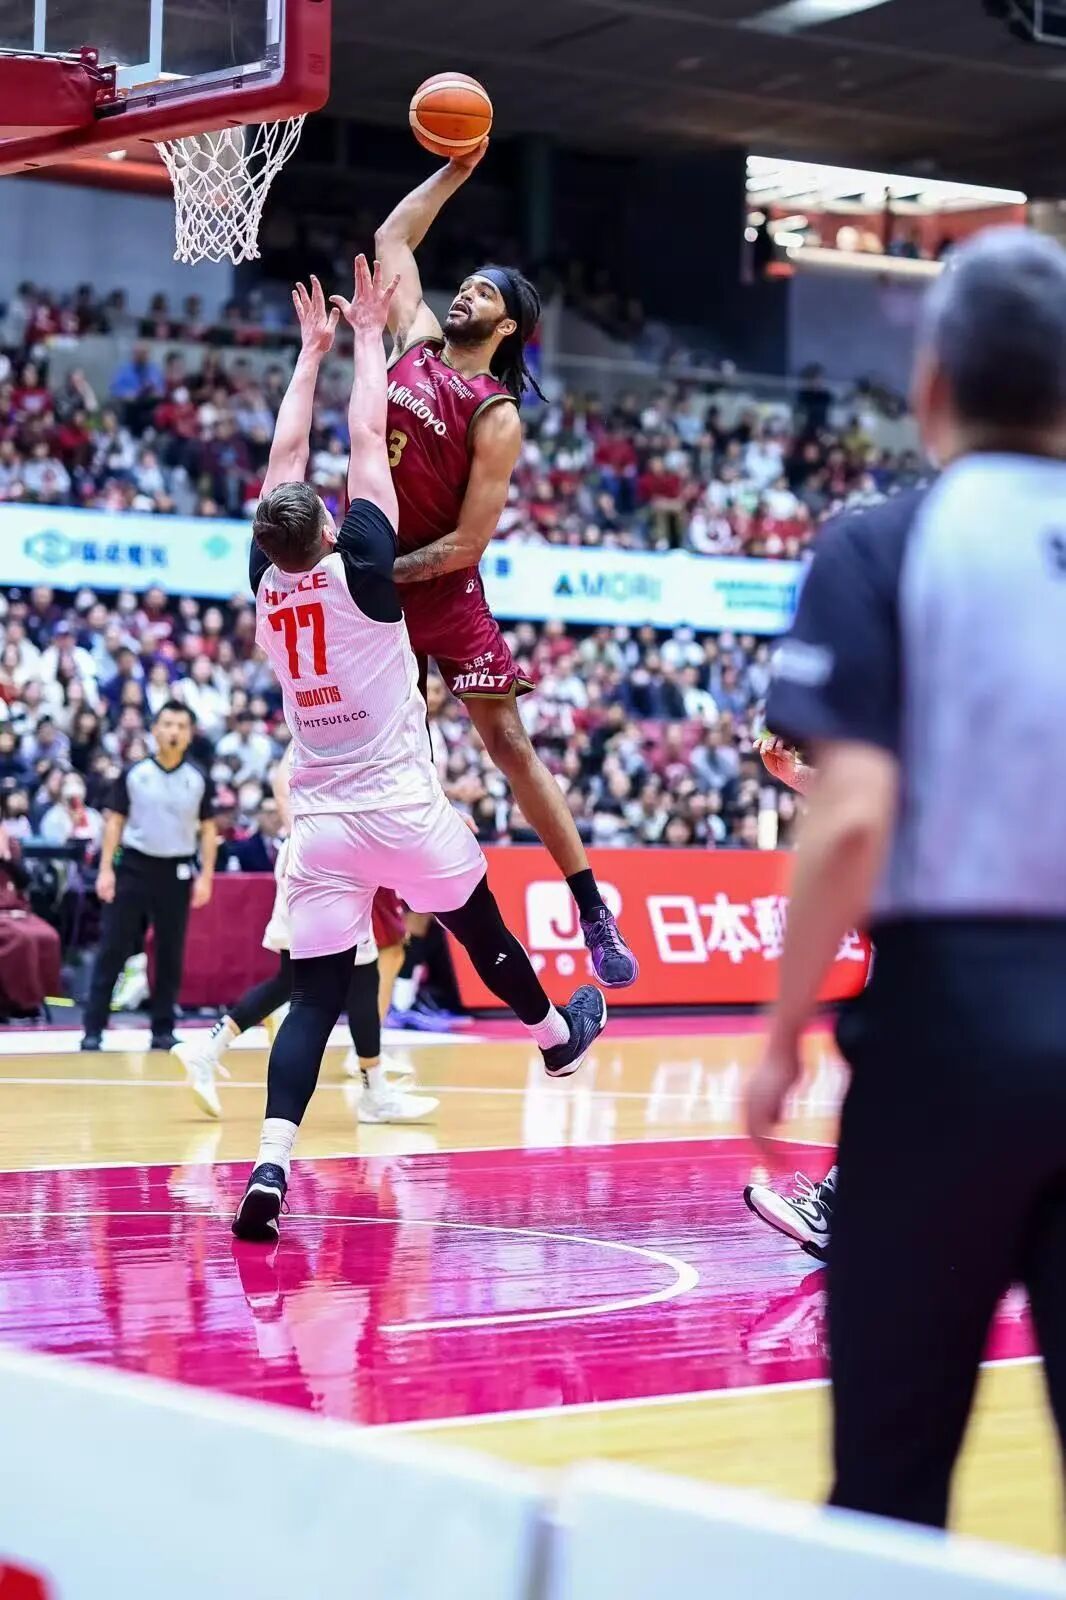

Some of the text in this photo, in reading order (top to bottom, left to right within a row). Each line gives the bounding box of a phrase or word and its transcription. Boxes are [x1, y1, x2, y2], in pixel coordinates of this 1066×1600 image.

[387, 380, 447, 436] Mitutoyo
[267, 602, 328, 680] 77
[295, 686, 342, 707] GUDAITIS
